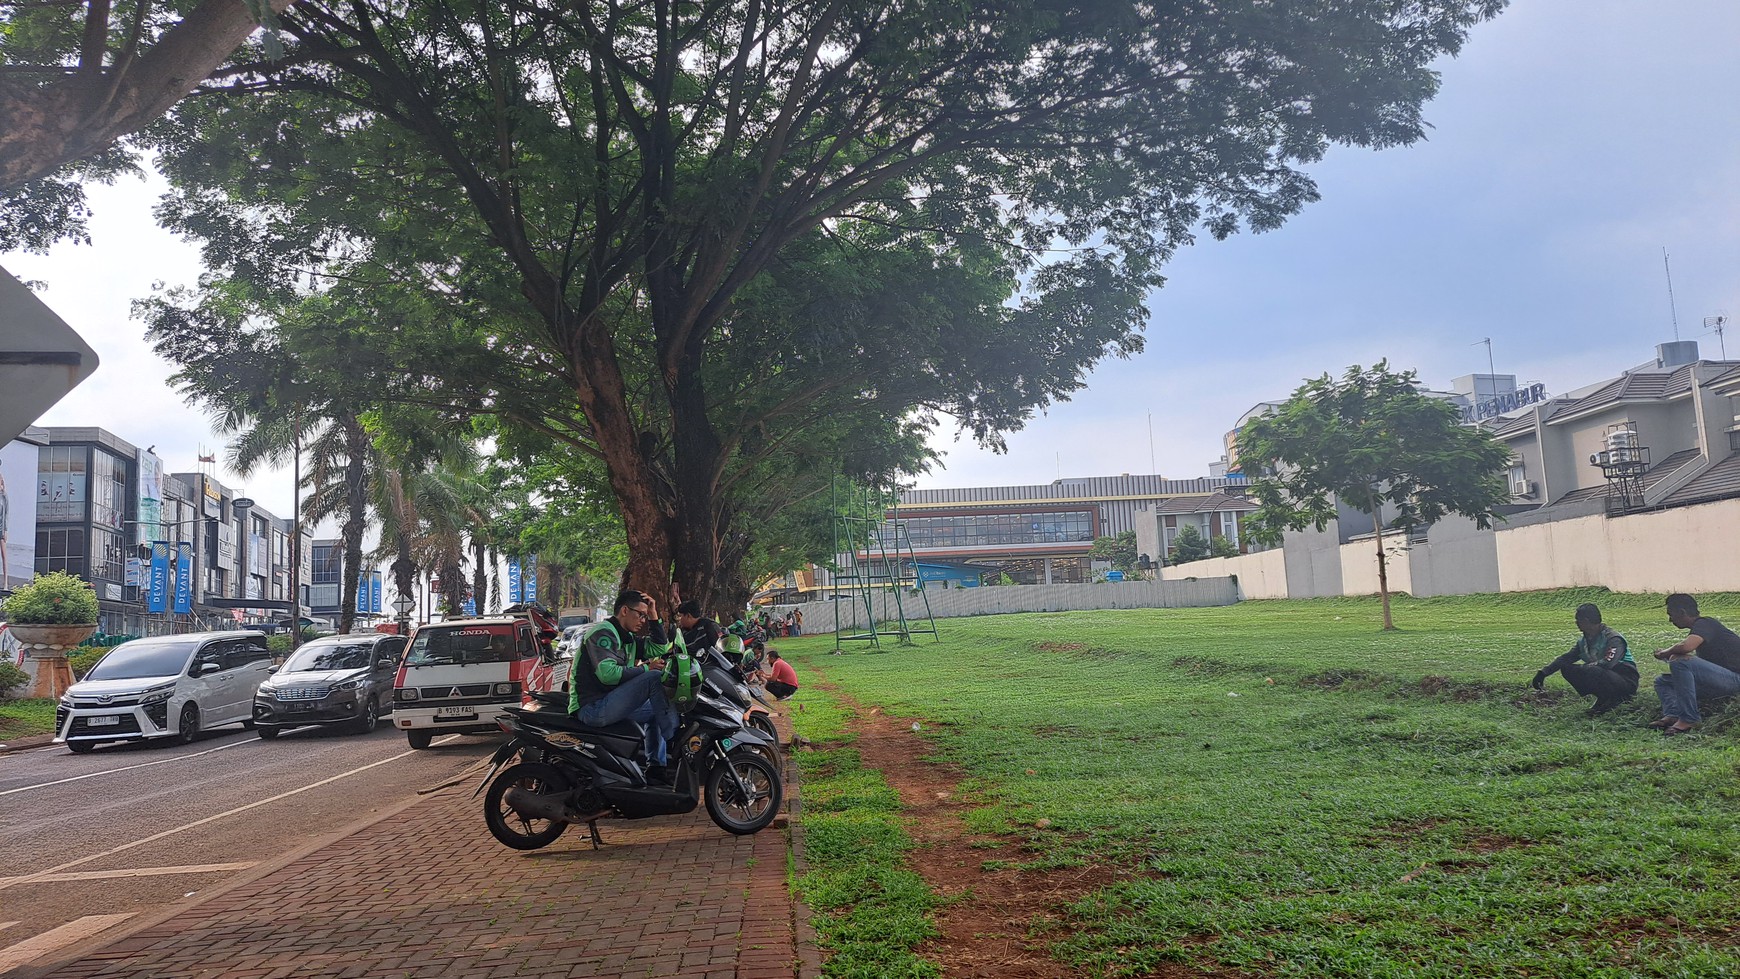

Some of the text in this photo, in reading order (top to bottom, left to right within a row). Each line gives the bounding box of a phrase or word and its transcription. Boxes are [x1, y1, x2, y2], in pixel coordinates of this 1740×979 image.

[1476, 382, 1546, 421] PENABUR
[153, 566, 163, 603] DEVANT
[178, 568, 188, 604] DEVANT
[510, 561, 518, 600] DEVAN
[449, 629, 491, 637] HONDA
